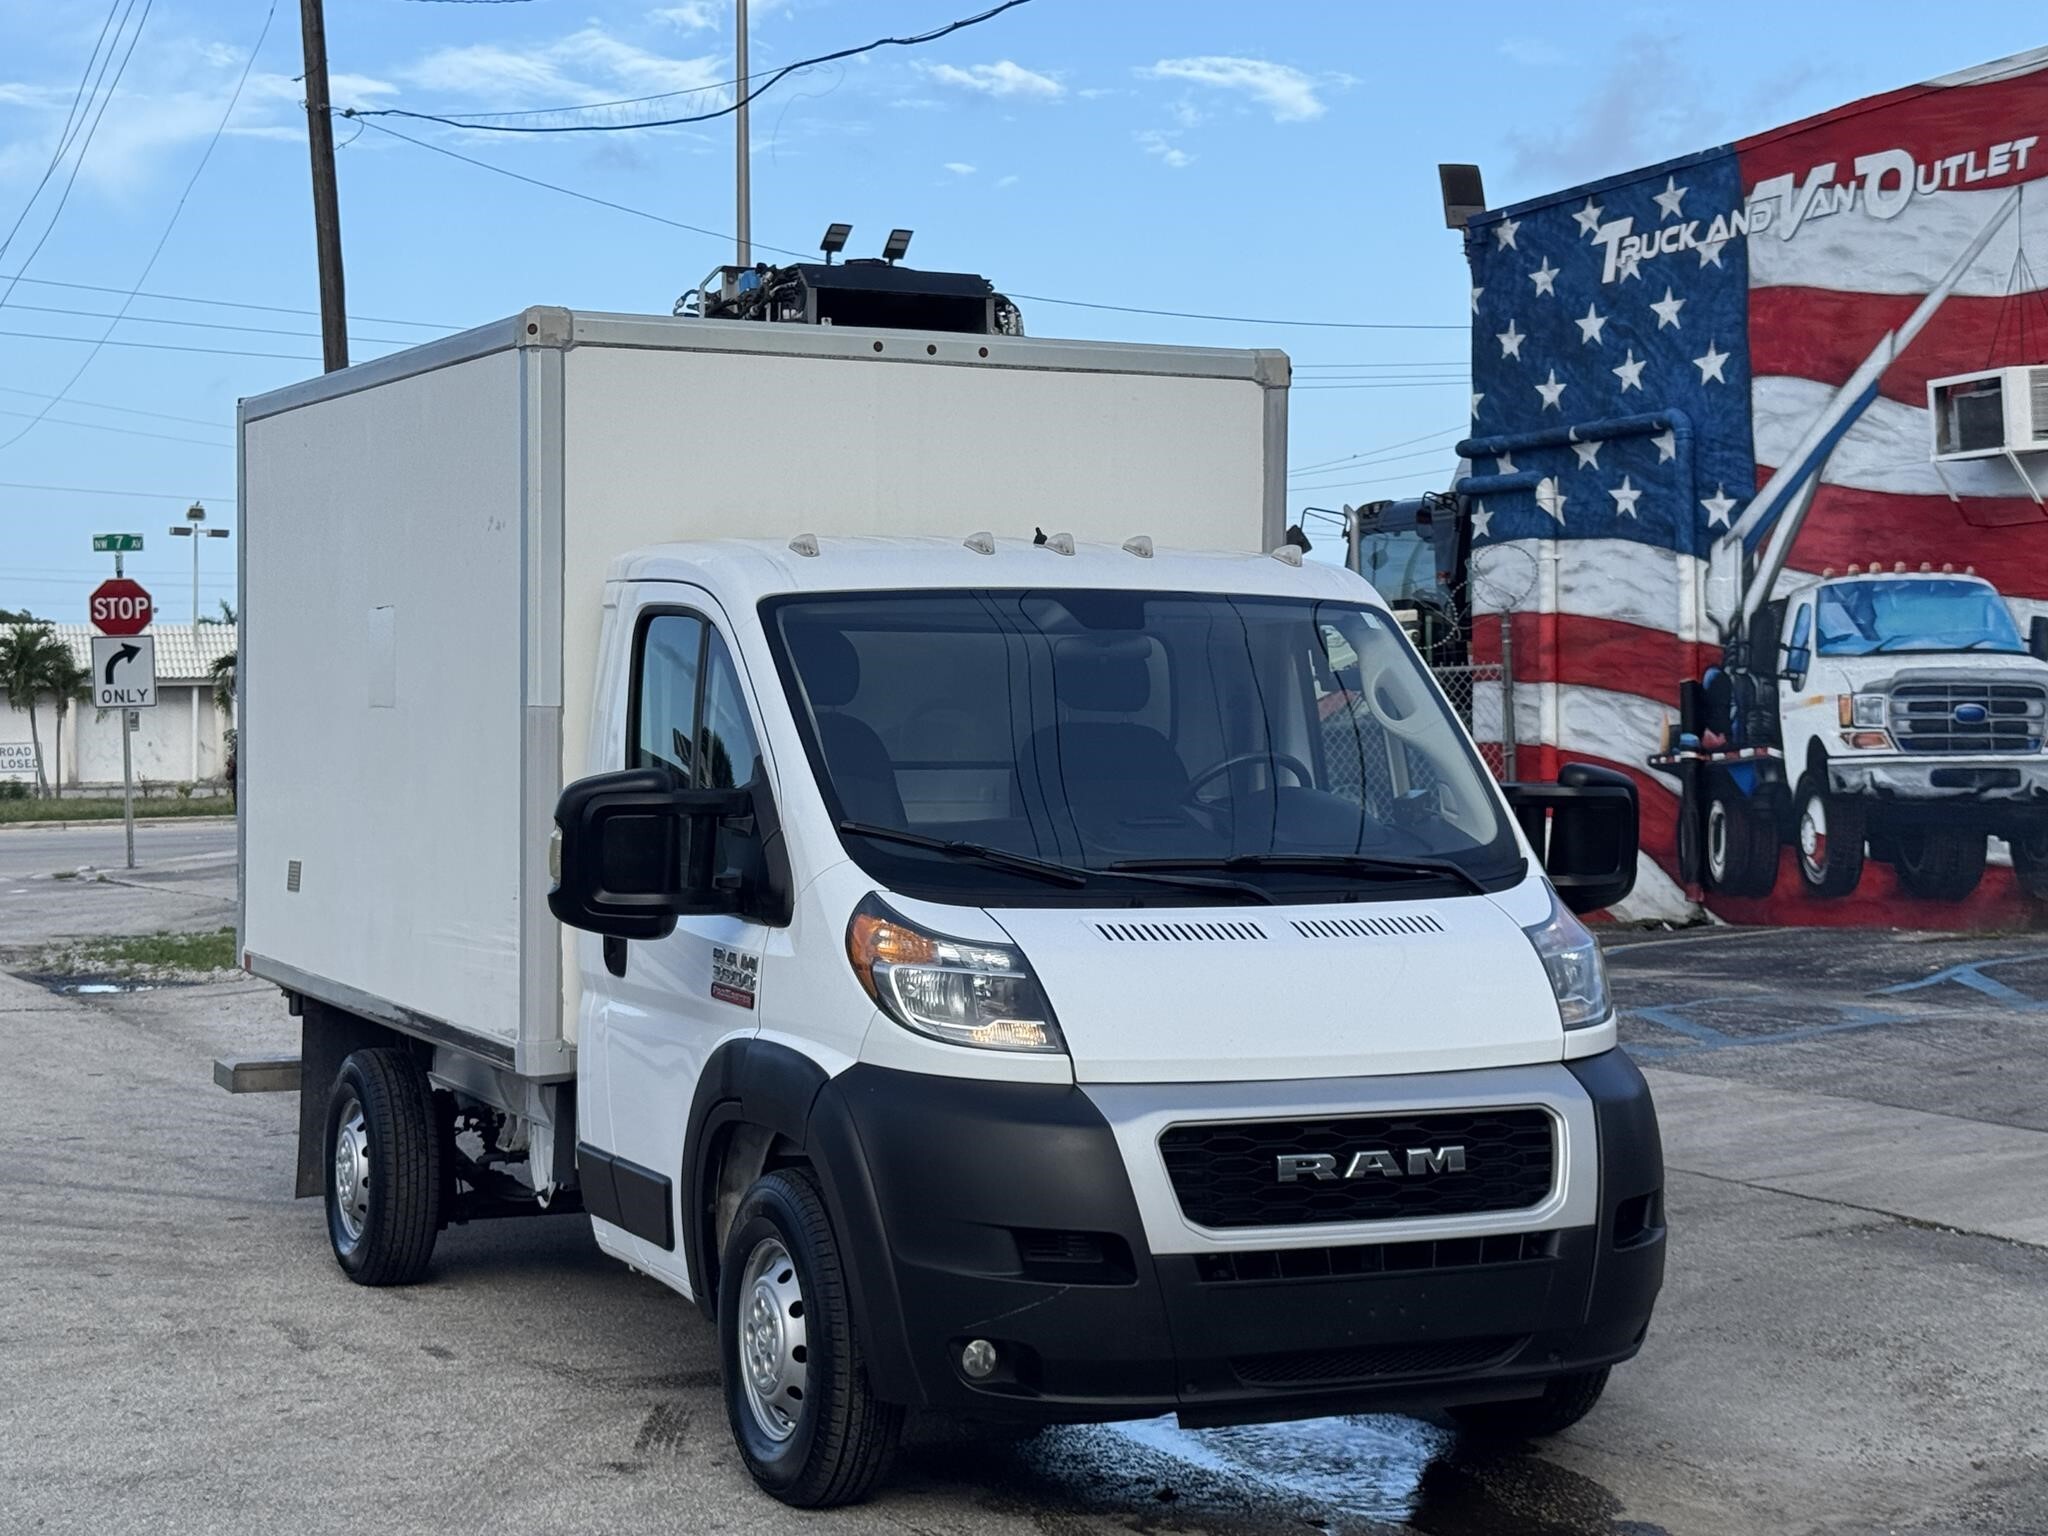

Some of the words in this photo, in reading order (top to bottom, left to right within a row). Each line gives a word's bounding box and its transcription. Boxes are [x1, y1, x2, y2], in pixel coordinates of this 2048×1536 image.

[1591, 216, 1701, 284] TRUCK
[1705, 198, 1773, 244] AND
[1748, 161, 1857, 241] VAN
[1853, 135, 2039, 220] OUTLET
[94, 539, 108, 549] NW
[114, 535, 124, 549] 7
[94, 597, 149, 621] STOP
[102, 688, 149, 704] ONLY
[0, 746, 32, 757] ROAD
[0, 758, 39, 769] LOSED
[712, 947, 759, 974] RAM
[1276, 1145, 1466, 1183] RAM
